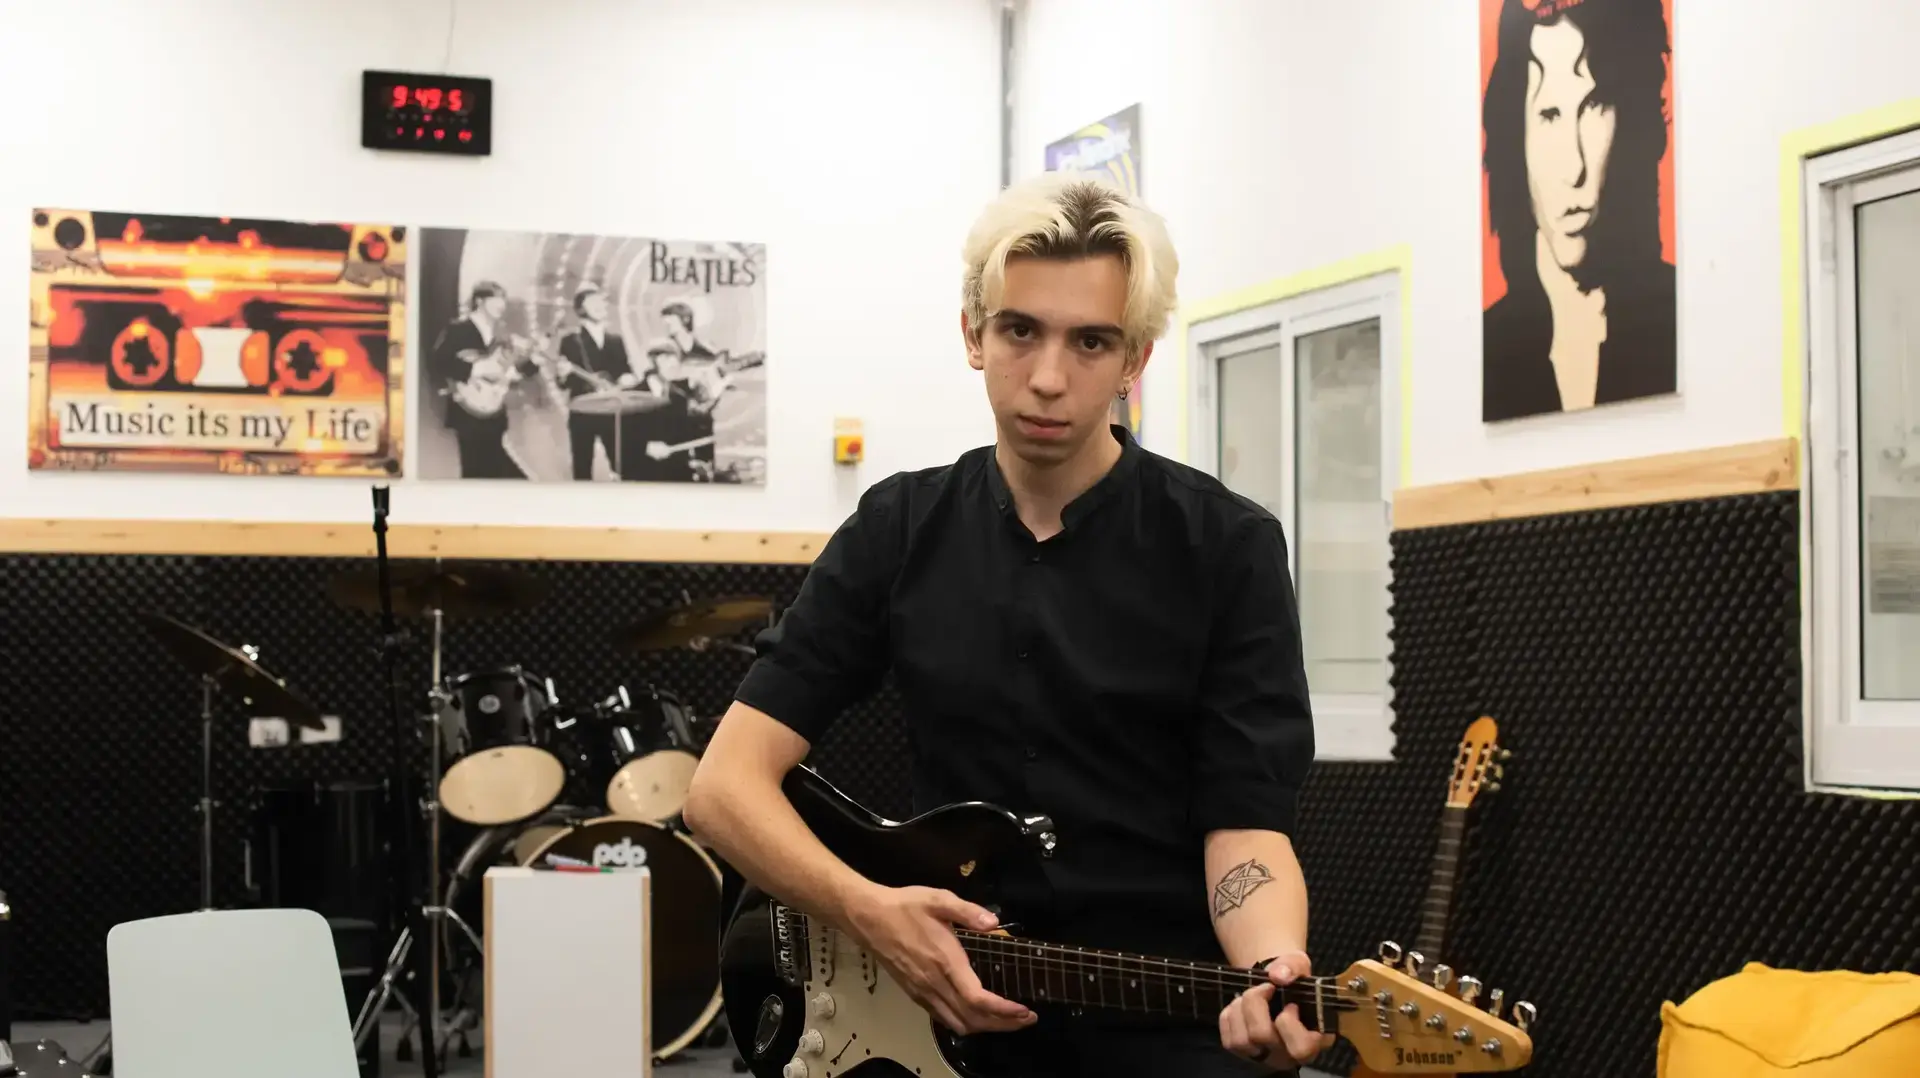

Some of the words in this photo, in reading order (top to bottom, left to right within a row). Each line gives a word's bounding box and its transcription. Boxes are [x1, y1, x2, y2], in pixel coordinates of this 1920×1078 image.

[650, 241, 756, 293] BEATLES
[65, 402, 174, 436] Music
[186, 404, 229, 437] its
[240, 411, 295, 447] my
[305, 408, 371, 442] Life
[592, 836, 647, 868] pdp
